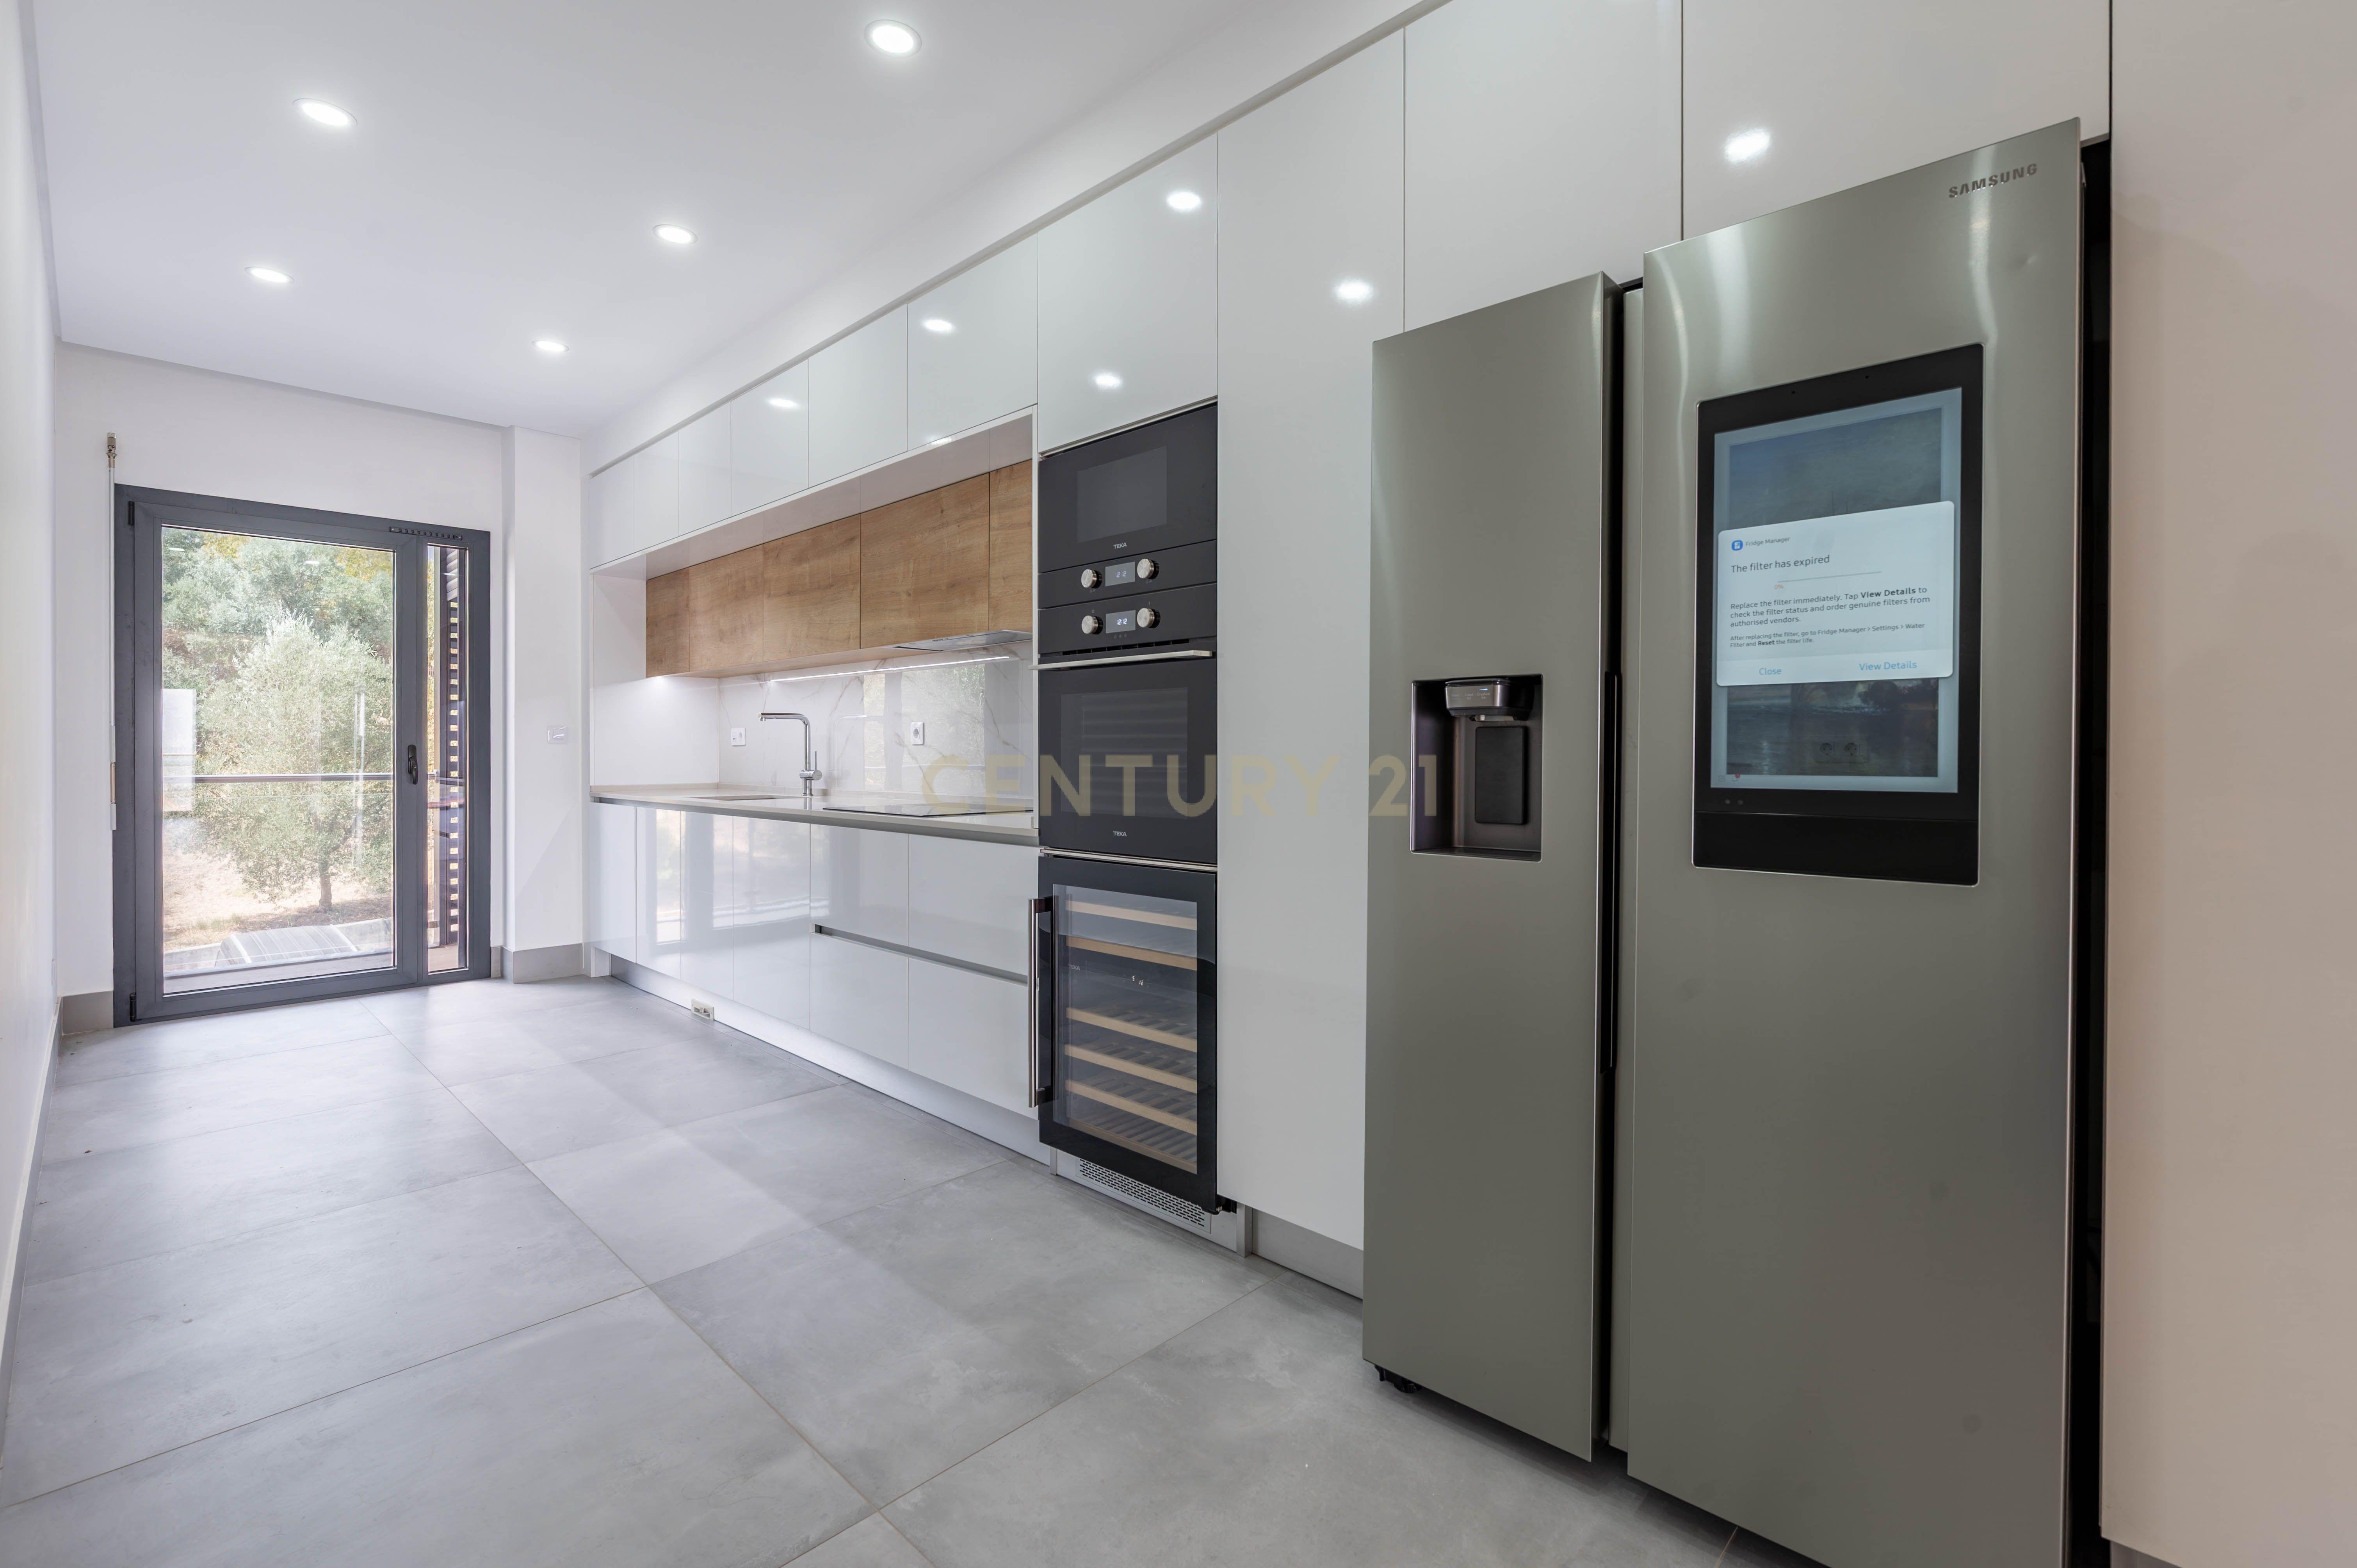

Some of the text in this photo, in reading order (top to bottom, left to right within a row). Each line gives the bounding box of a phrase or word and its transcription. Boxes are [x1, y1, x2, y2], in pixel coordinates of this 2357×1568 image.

[1949, 163, 2037, 198] SAMSUNG
[1750, 562, 1773, 571] filter
[1794, 555, 1830, 567] expired
[1793, 594, 1842, 604] immediately.
[1884, 587, 1916, 596] Details
[1849, 601, 1881, 610] genuine
[1730, 618, 1768, 627] authorised
[1884, 660, 1917, 670] Details
